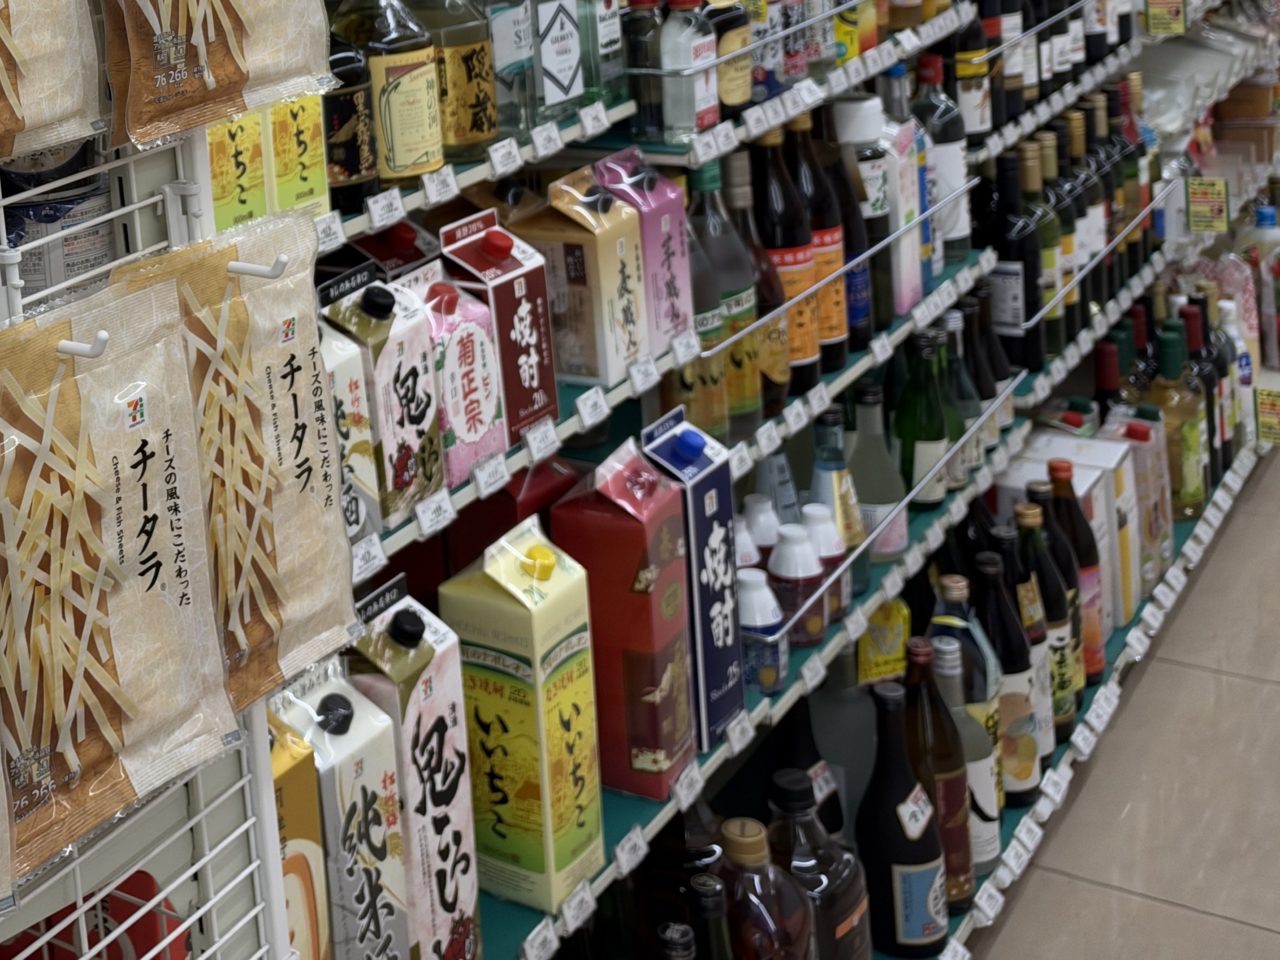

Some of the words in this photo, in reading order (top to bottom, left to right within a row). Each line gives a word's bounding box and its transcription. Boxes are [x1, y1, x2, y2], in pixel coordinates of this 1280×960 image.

[153, 72, 167, 89] 76
[168, 67, 189, 84] 266
[456, 332, 484, 434] 菊正宗
[509, 297, 540, 389] 焼酎
[112, 455, 121, 494] Cheese
[280, 353, 314, 494] チータラ
[116, 507, 124, 527] Fish
[116, 529, 125, 566] Sheets
[130, 438, 164, 593] チータラ
[162, 428, 191, 607] チーズの風味にこだわった
[700, 519, 736, 649] 焼酎
[471, 703, 509, 839] いいちこ
[558, 702, 586, 829] いいちこ
